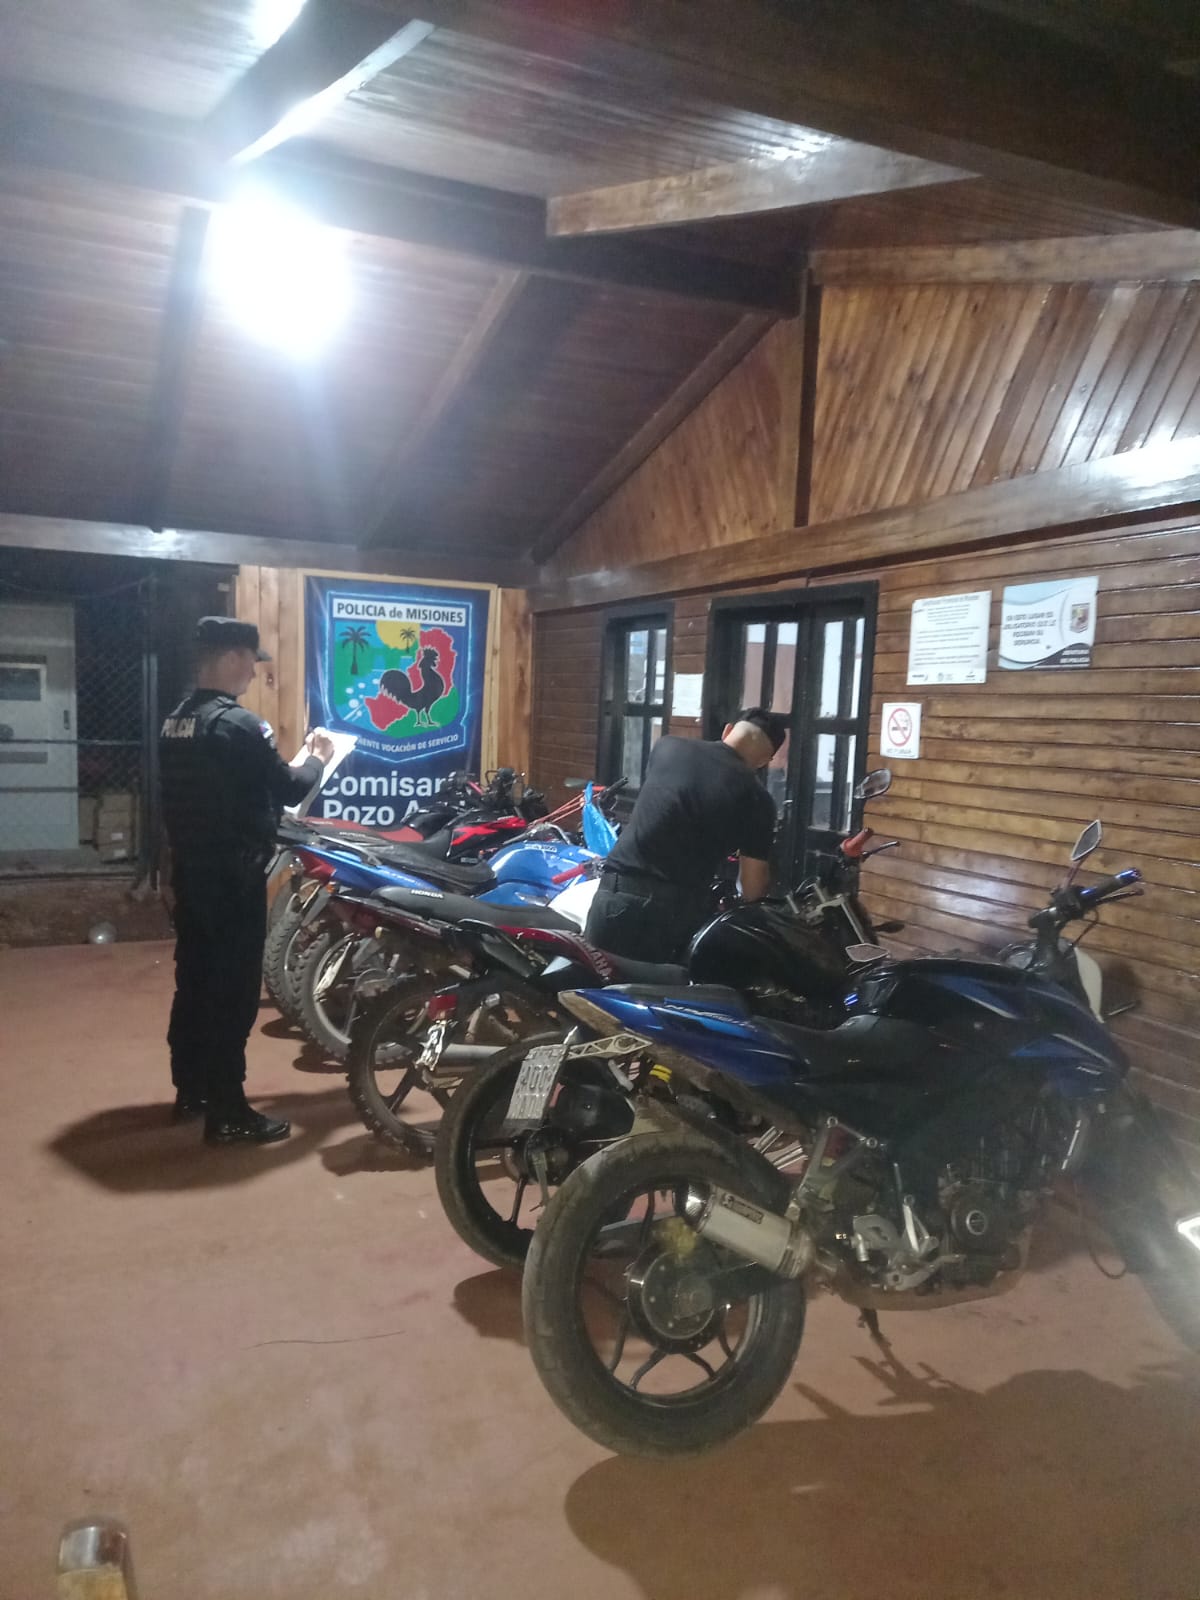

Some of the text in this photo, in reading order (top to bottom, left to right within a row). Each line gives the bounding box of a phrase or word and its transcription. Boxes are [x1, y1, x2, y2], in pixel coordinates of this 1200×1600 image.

[336, 602, 464, 623] POLICIA de MISIONES
[381, 741, 417, 753] VOCACIÓN
[418, 741, 428, 750] DE
[428, 733, 459, 748] SERVICIO
[323, 800, 396, 826] Pozo
[410, 889, 444, 899] HONDA
